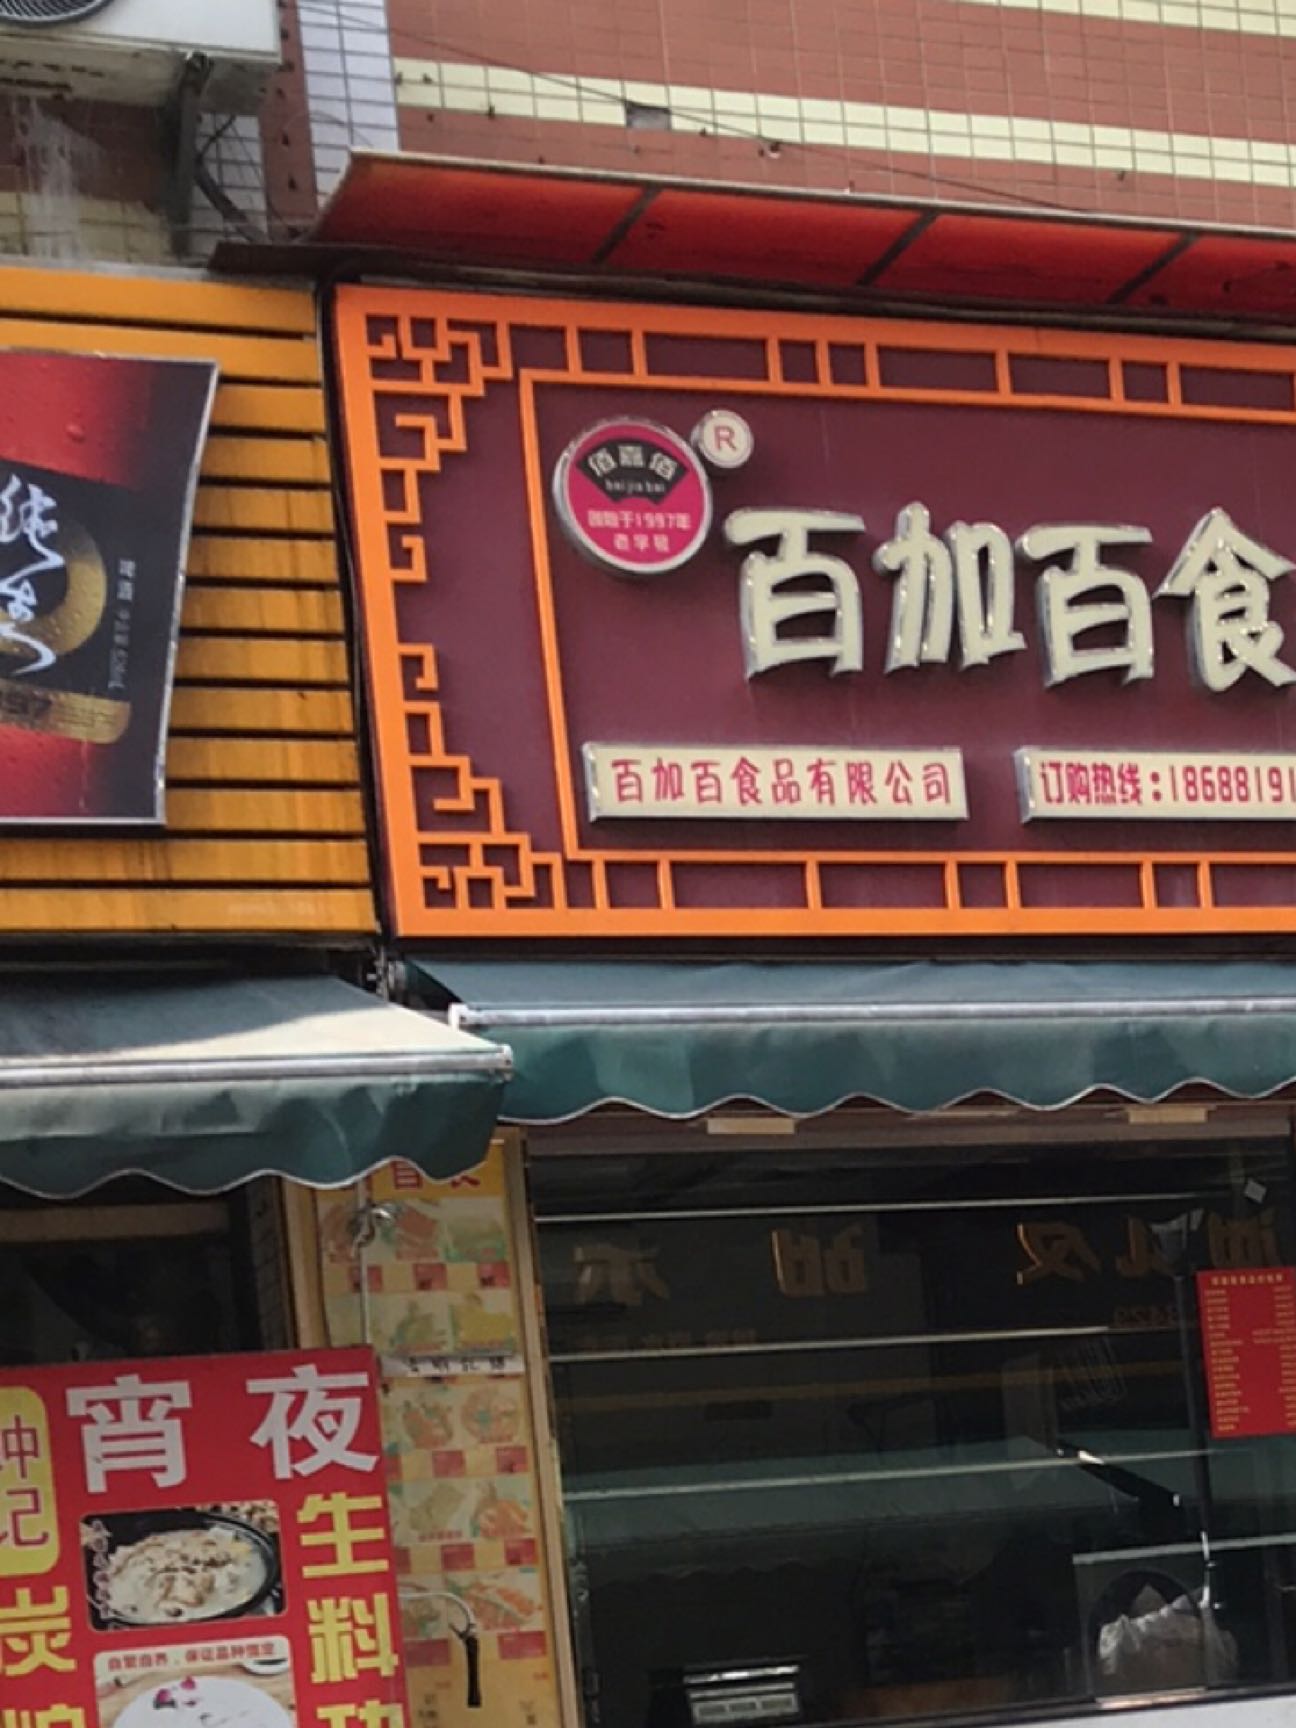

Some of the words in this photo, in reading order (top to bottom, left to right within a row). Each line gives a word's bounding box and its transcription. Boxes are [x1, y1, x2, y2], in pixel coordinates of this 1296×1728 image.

[611, 755, 951, 806] 百加百食品有限公司
